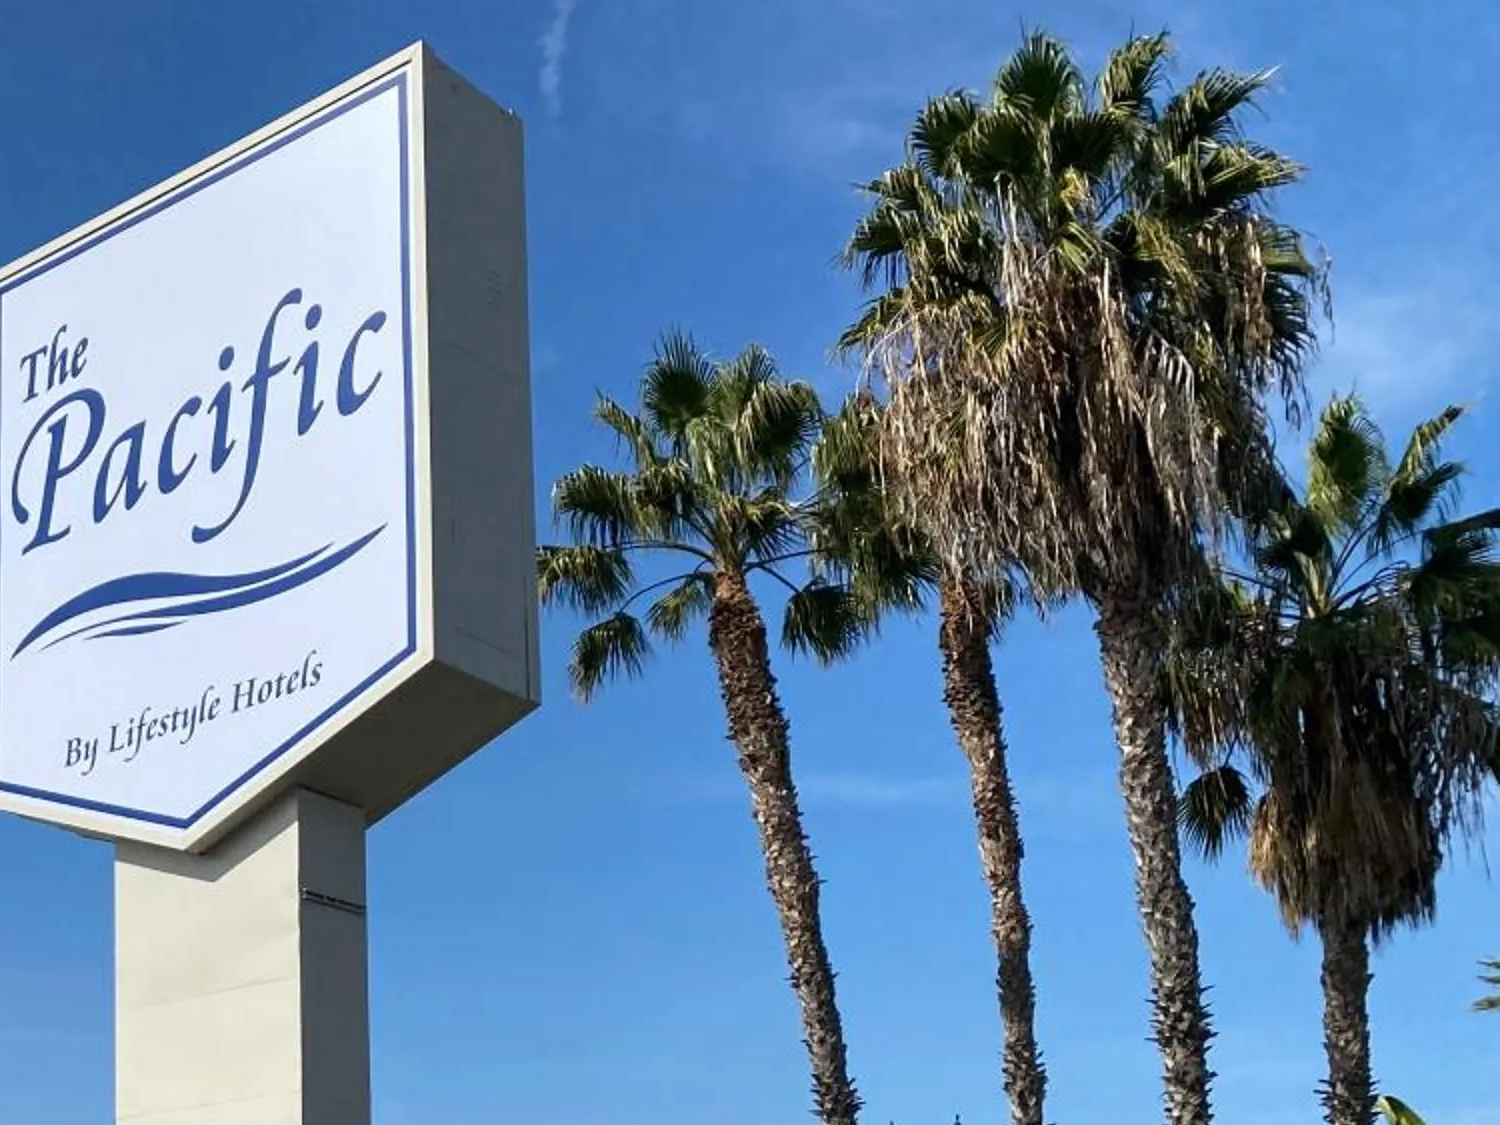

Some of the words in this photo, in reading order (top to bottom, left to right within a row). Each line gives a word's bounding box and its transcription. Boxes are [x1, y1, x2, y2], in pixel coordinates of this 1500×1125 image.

[11, 287, 387, 556] Pacific
[19, 324, 88, 404] The
[64, 736, 100, 776] By
[108, 685, 221, 763] Lifestyle
[230, 649, 323, 714] Hotels
